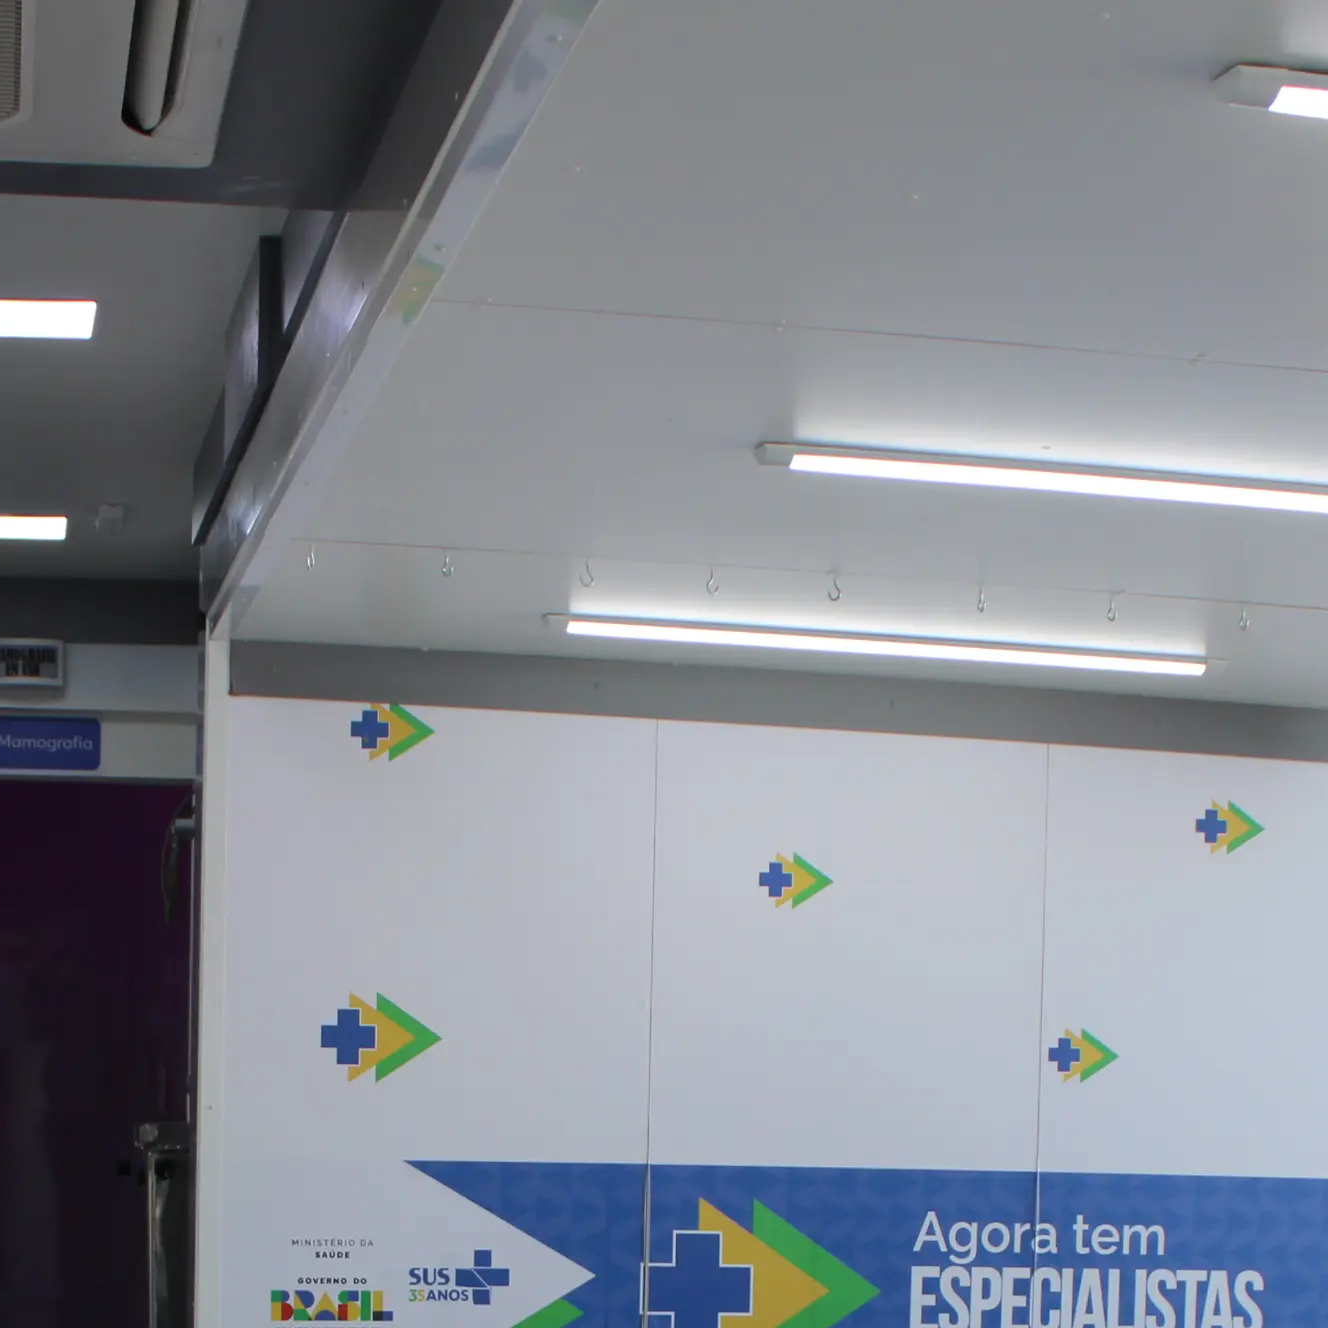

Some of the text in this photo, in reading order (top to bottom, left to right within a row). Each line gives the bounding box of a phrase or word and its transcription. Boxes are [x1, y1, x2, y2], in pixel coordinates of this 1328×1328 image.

[291, 1238, 374, 1247] MINISTÉRIO DA
[912, 1211, 1166, 1264] Agora tem
[315, 1250, 350, 1259] SAÚDE
[297, 1277, 368, 1285] GOVERNO DO
[408, 1267, 450, 1286] SUS
[270, 1290, 393, 1321] BRASIL
